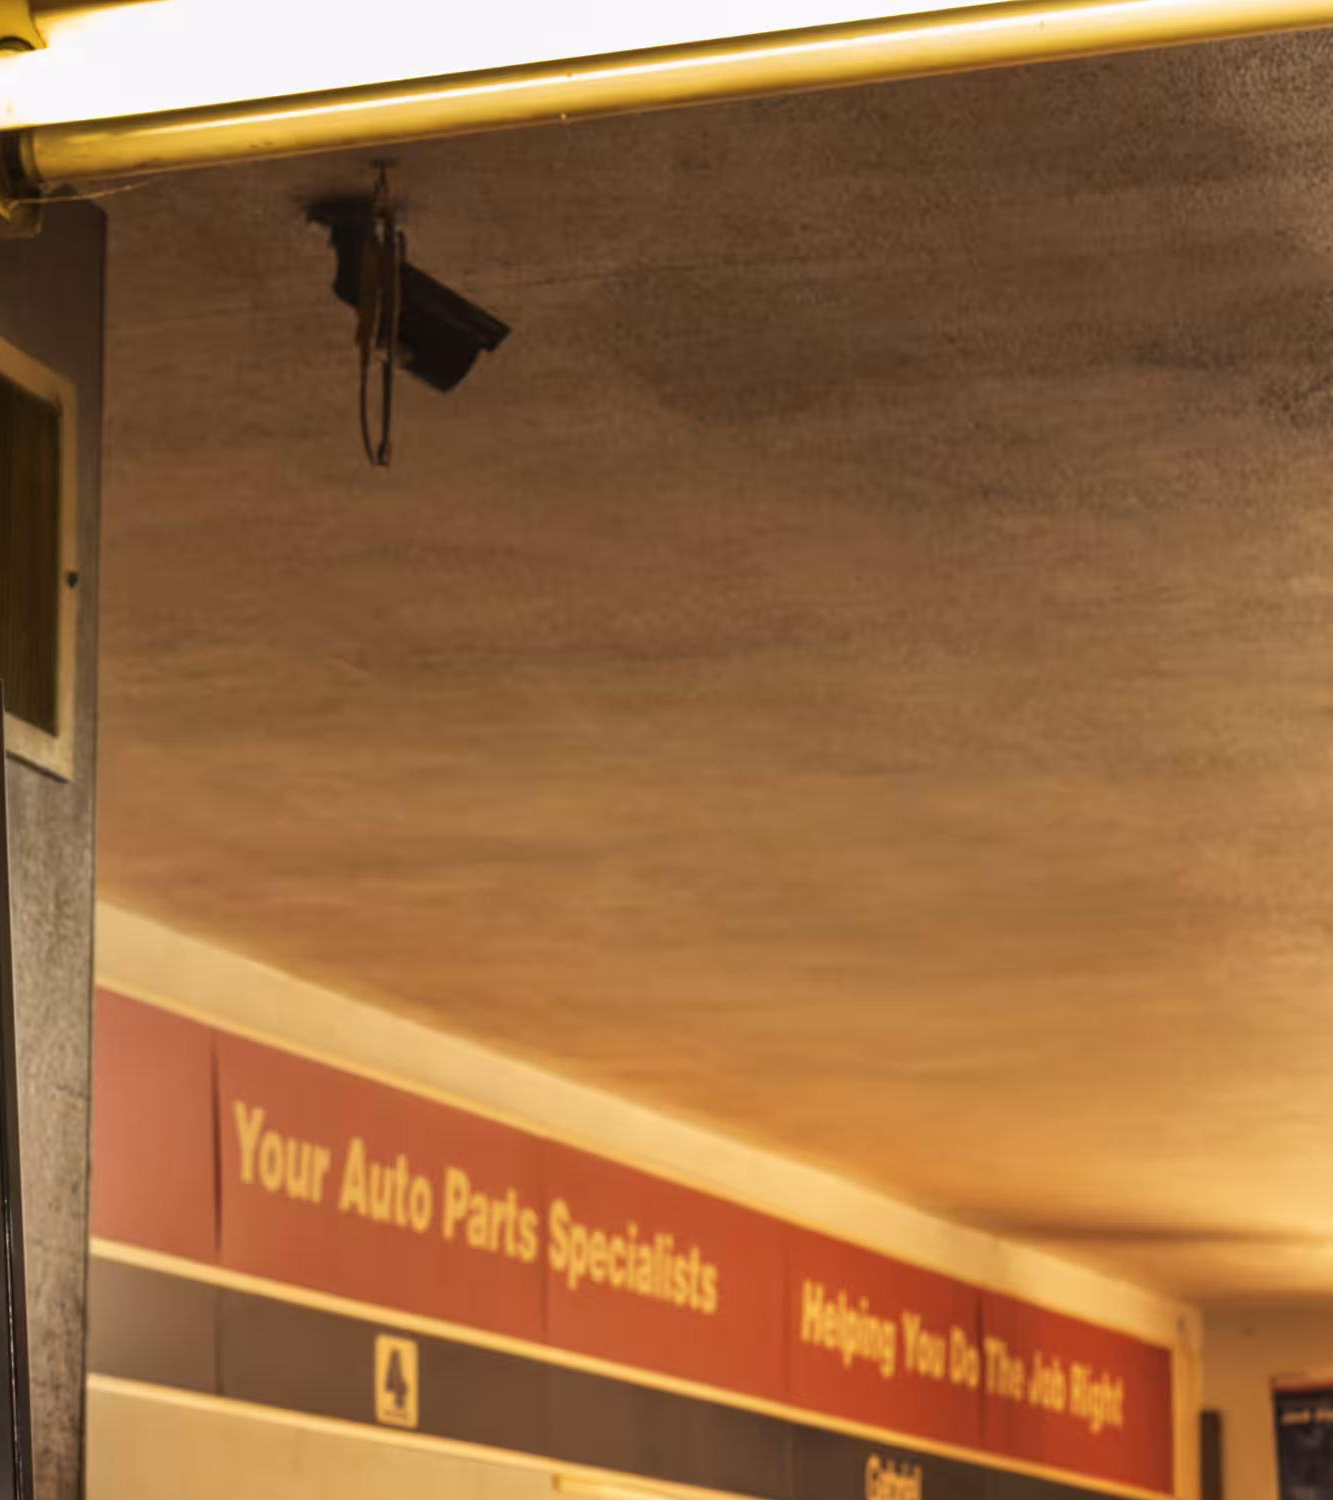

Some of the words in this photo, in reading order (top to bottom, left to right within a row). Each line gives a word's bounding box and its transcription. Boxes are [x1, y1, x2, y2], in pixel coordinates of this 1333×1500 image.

[234, 1100, 330, 1203] Your
[339, 1137, 432, 1233] Auto
[444, 1166, 538, 1262] Parts
[548, 1198, 719, 1315] Specialists
[801, 1280, 895, 1378] Helping
[902, 1311, 945, 1378] You
[949, 1326, 980, 1390] Do
[985, 1336, 1023, 1401] The
[1028, 1350, 1066, 1412] Job
[1070, 1361, 1123, 1433] Right
